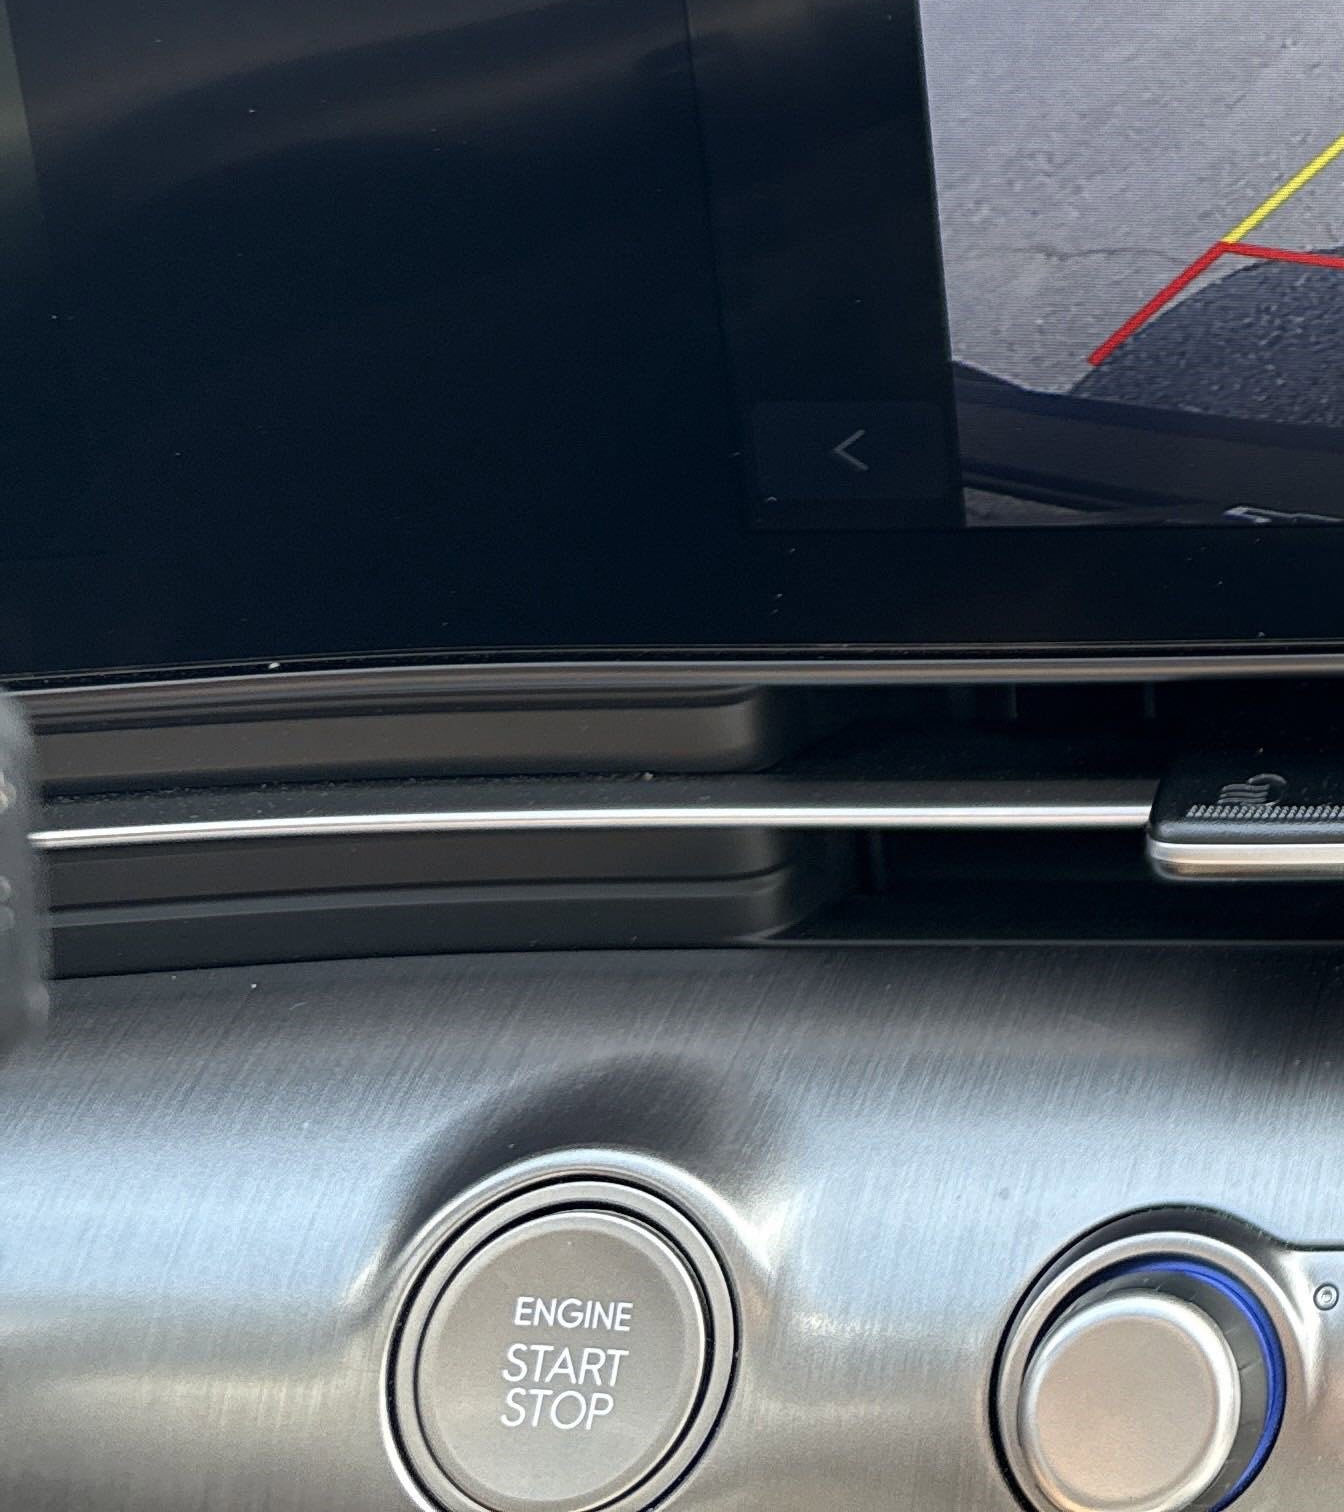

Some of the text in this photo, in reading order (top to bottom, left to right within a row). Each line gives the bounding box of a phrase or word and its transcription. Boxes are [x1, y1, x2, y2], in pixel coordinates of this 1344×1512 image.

[513, 1296, 633, 1333] ENGINE
[501, 1344, 629, 1388] START
[500, 1387, 614, 1430] STOP
